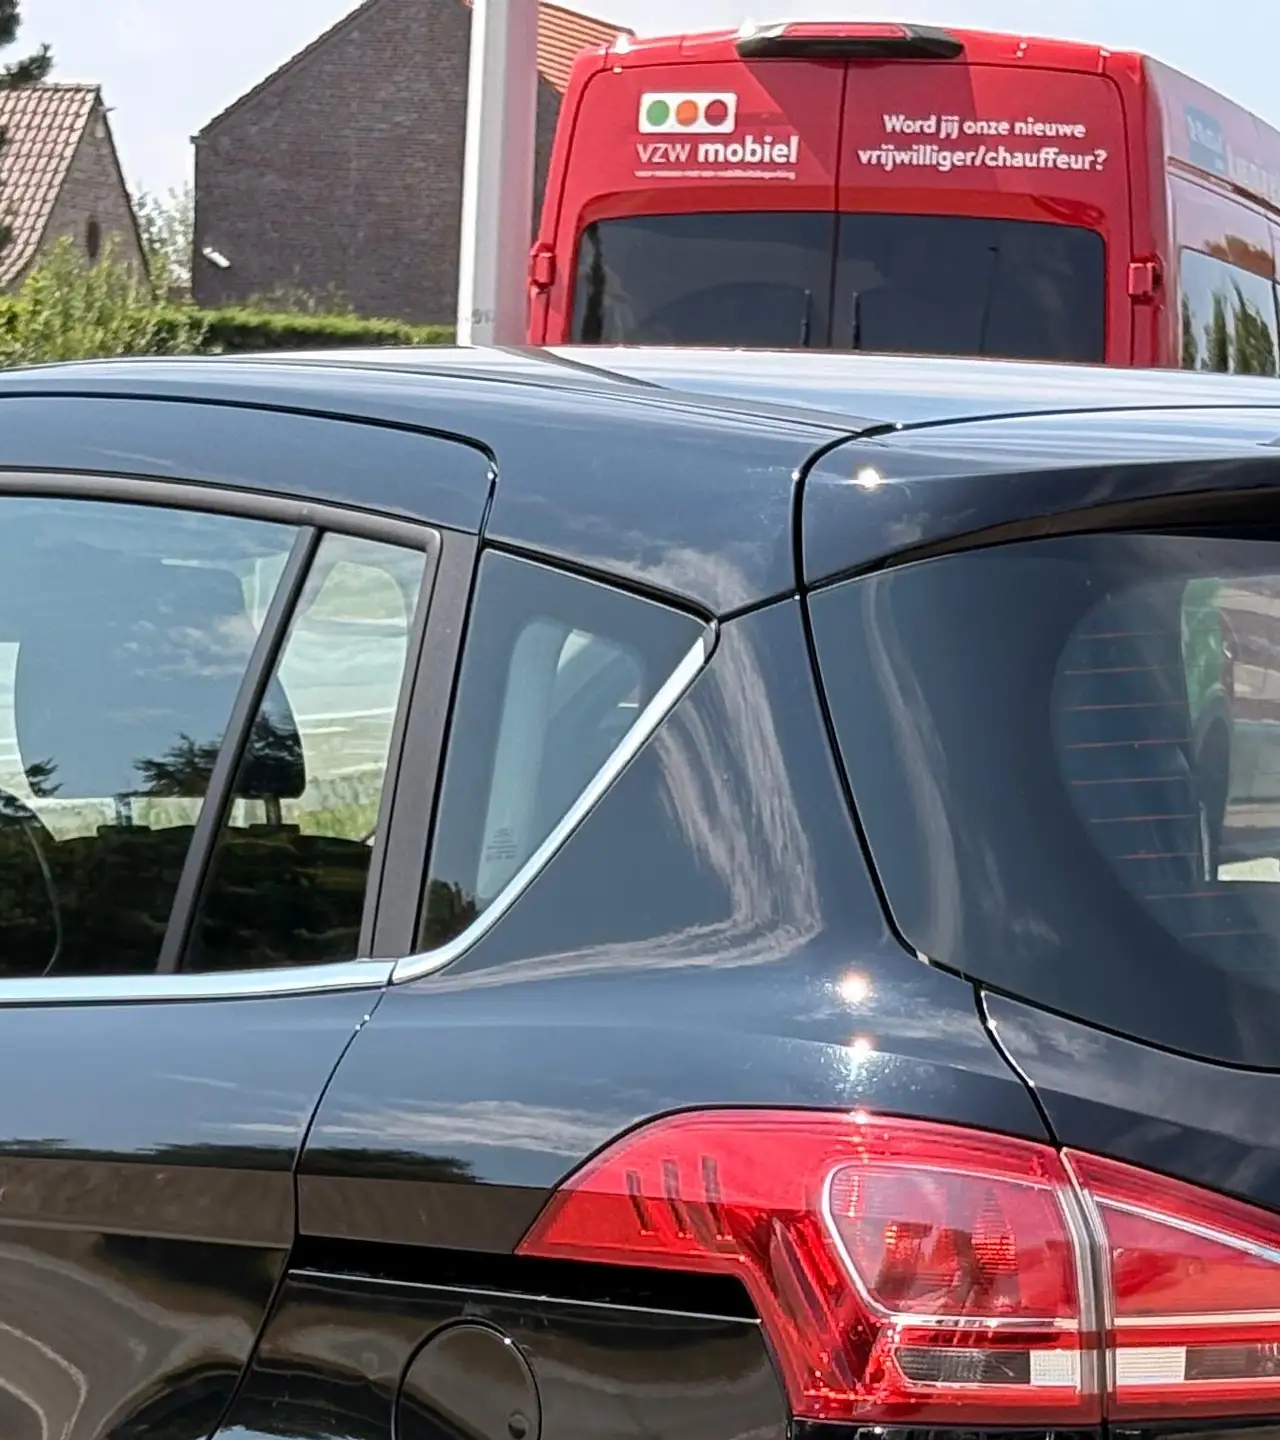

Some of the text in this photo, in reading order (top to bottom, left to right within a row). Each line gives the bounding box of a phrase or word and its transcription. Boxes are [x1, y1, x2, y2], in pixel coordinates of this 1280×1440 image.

[883, 114, 1087, 139] Word jij onze nieuwe
[697, 135, 799, 164] mobiel
[857, 144, 1109, 172] vrijwilliger/chauffeur?
